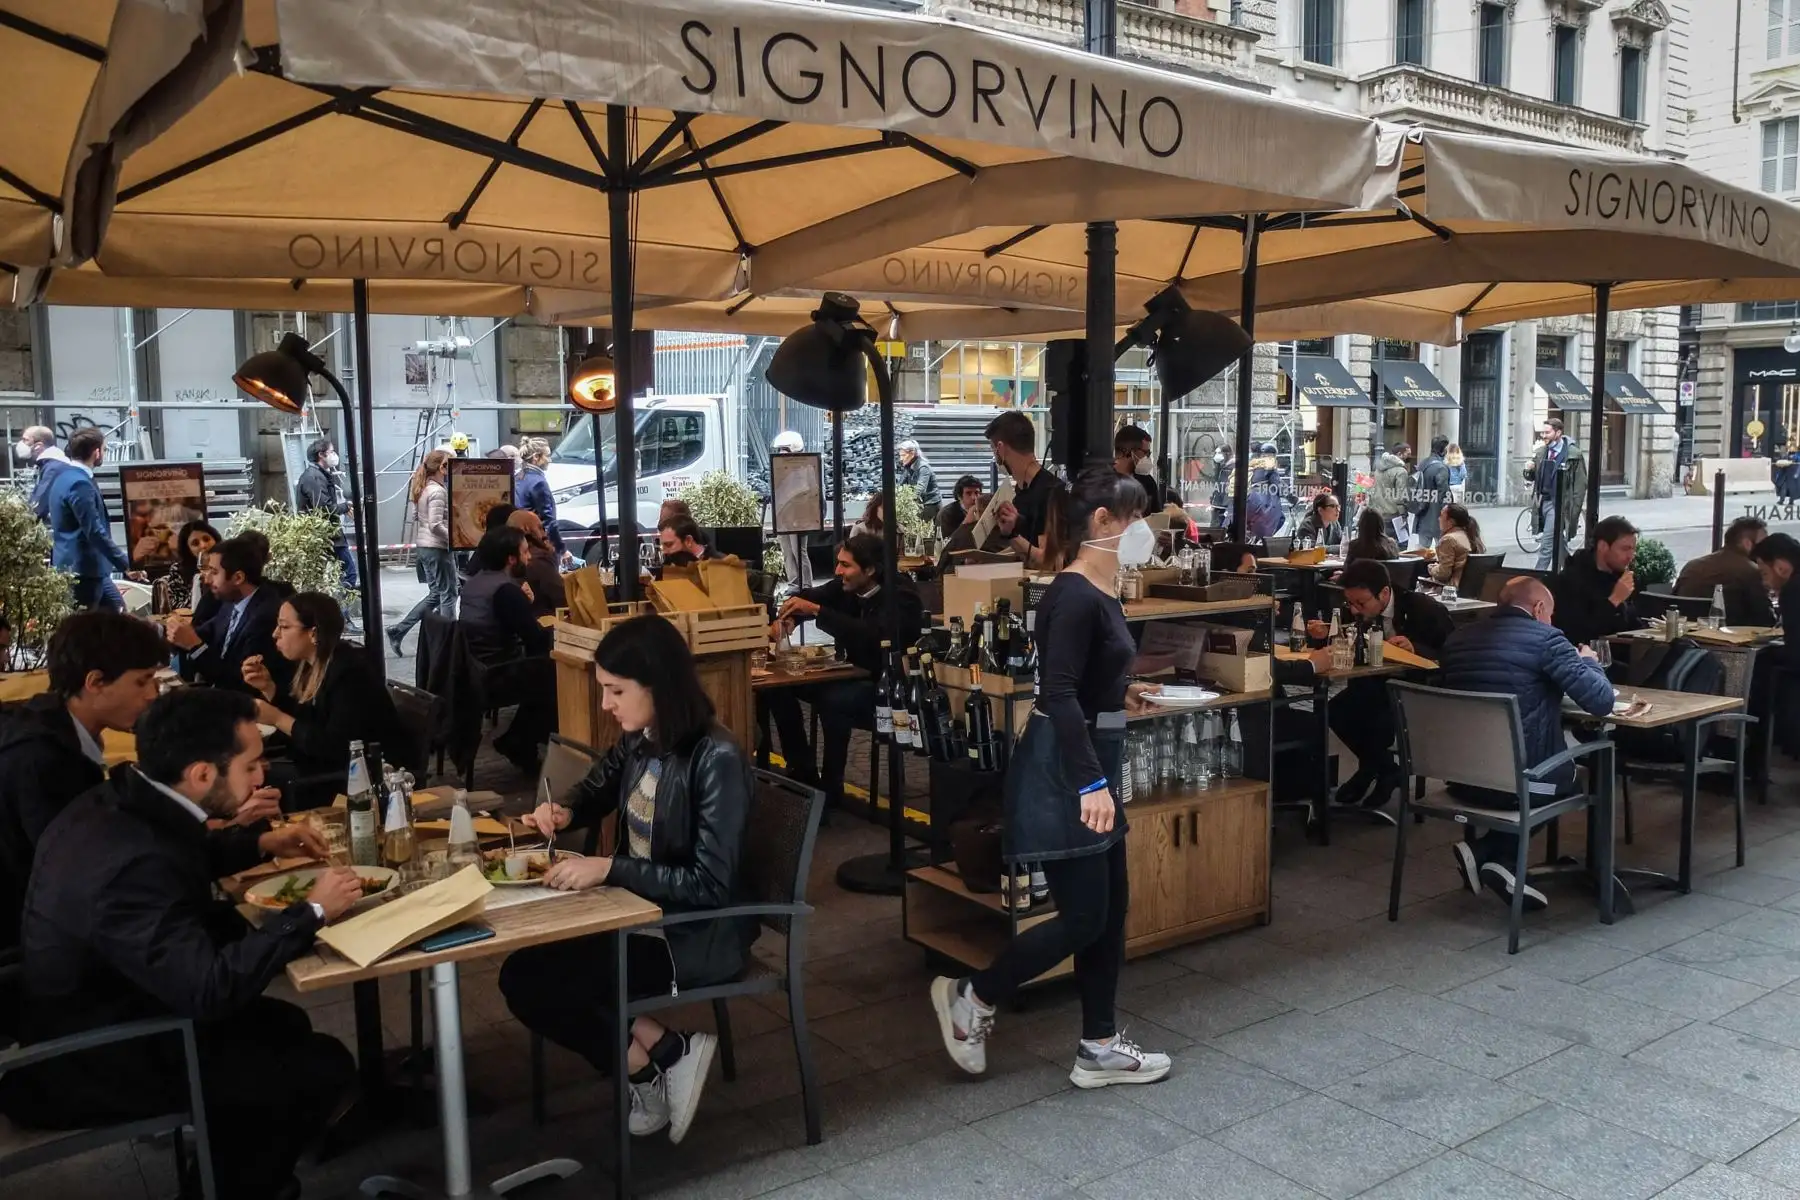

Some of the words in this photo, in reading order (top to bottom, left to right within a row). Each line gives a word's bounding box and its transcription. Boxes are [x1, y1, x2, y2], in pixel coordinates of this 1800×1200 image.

[680, 21, 1183, 158] SIGNORVINO
[1565, 169, 1770, 246] SIGNORVINO
[1303, 387, 1358, 395] GUTTERIDGE
[1394, 389, 1445, 397] GUTTERIDGE
[136, 469, 188, 479] SIGNORVINO
